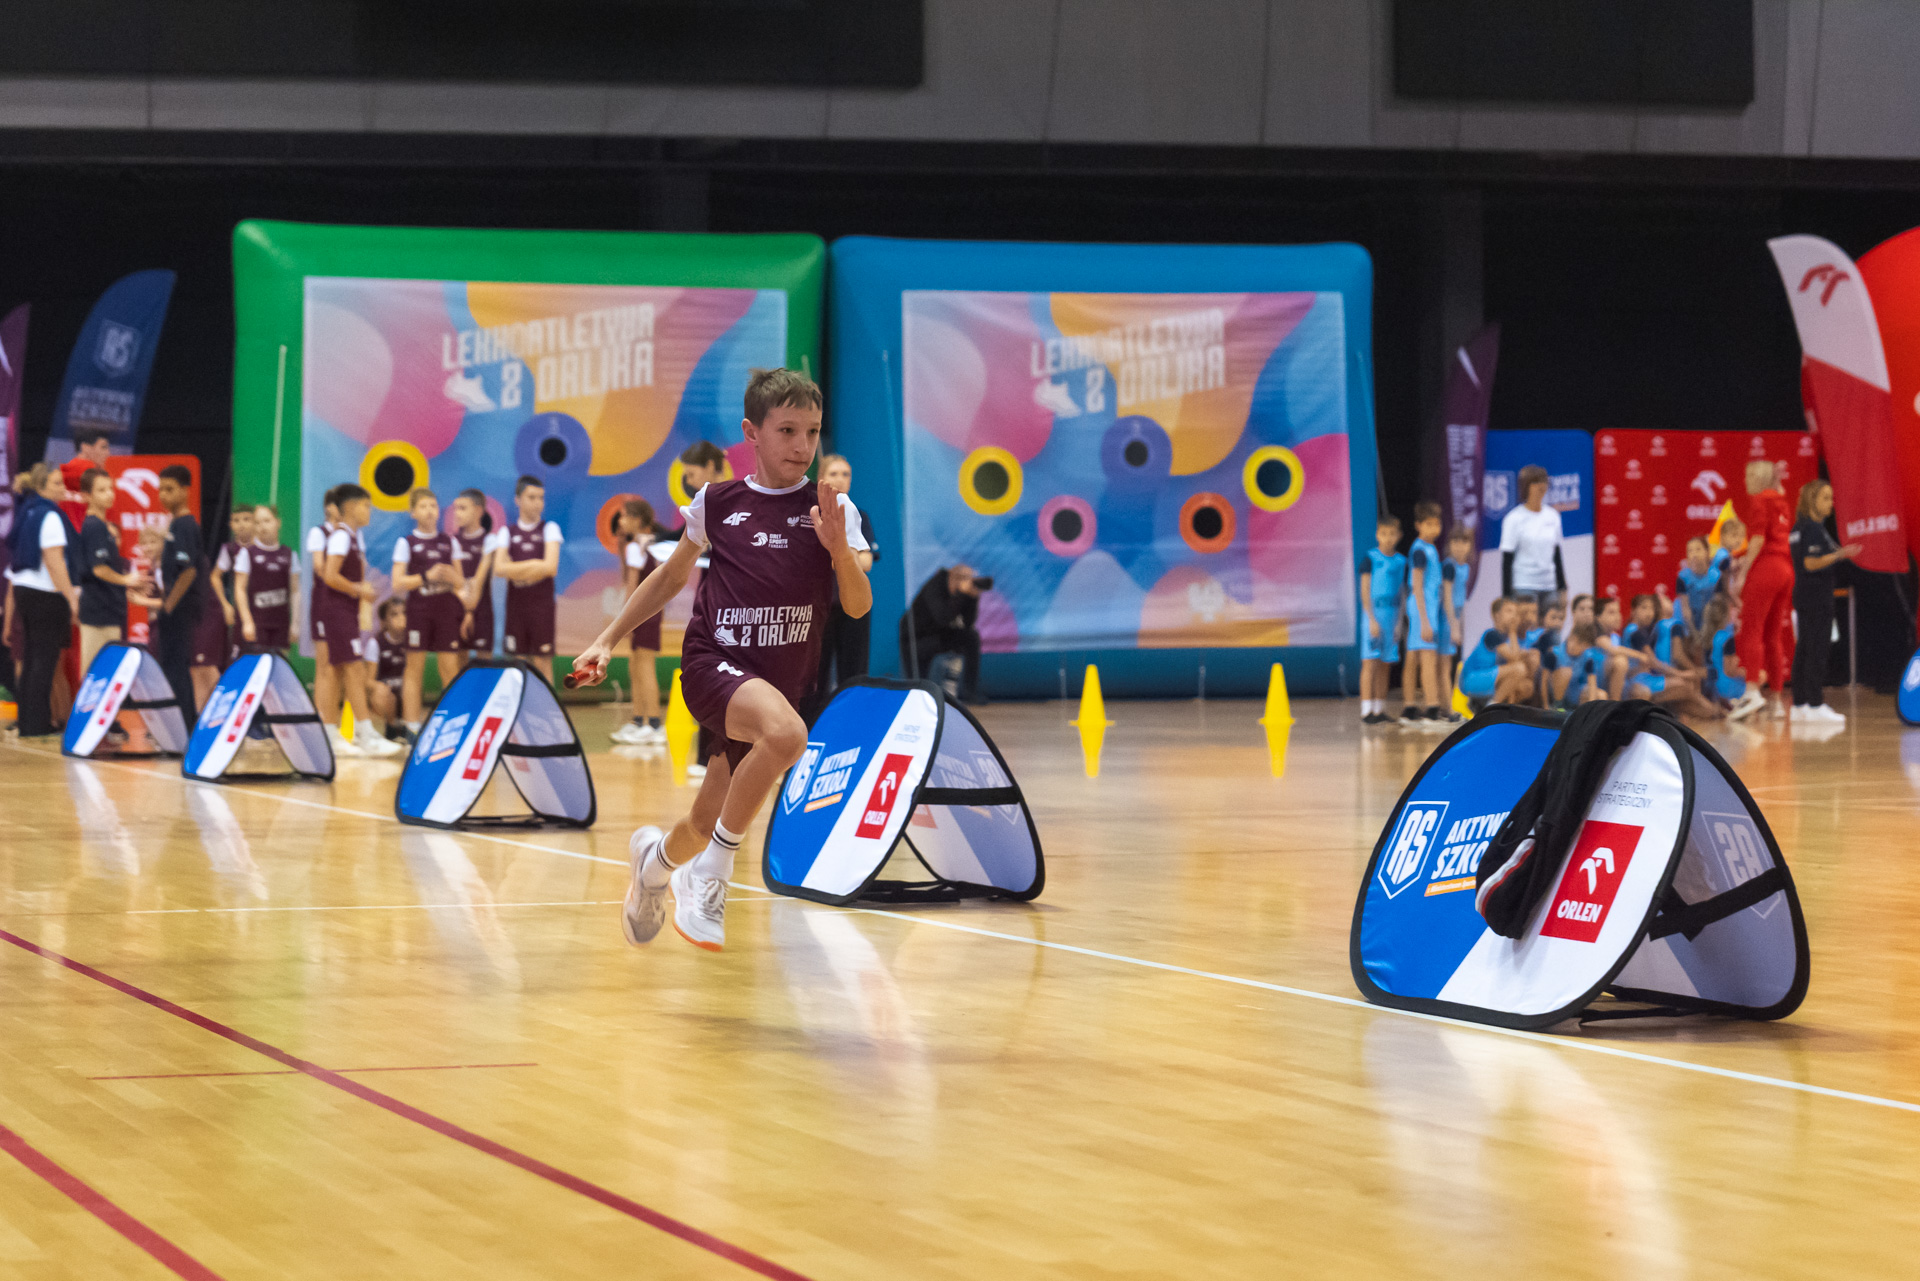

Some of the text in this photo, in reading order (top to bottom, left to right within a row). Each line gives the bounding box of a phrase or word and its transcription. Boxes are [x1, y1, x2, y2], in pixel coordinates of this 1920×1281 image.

[722, 512, 752, 526] 4F
[1686, 505, 1723, 520] ORLE
[716, 604, 813, 626] LEKKOATLETYKA
[757, 622, 811, 647] ORLIKA
[1612, 780, 1648, 795] PARTNER
[1596, 793, 1653, 808] STRATEGICZNY
[1444, 811, 1510, 845] AKTYW
[1386, 809, 1438, 885] AS
[1431, 840, 1489, 880] SZKO
[1557, 899, 1603, 923] ORLEN
